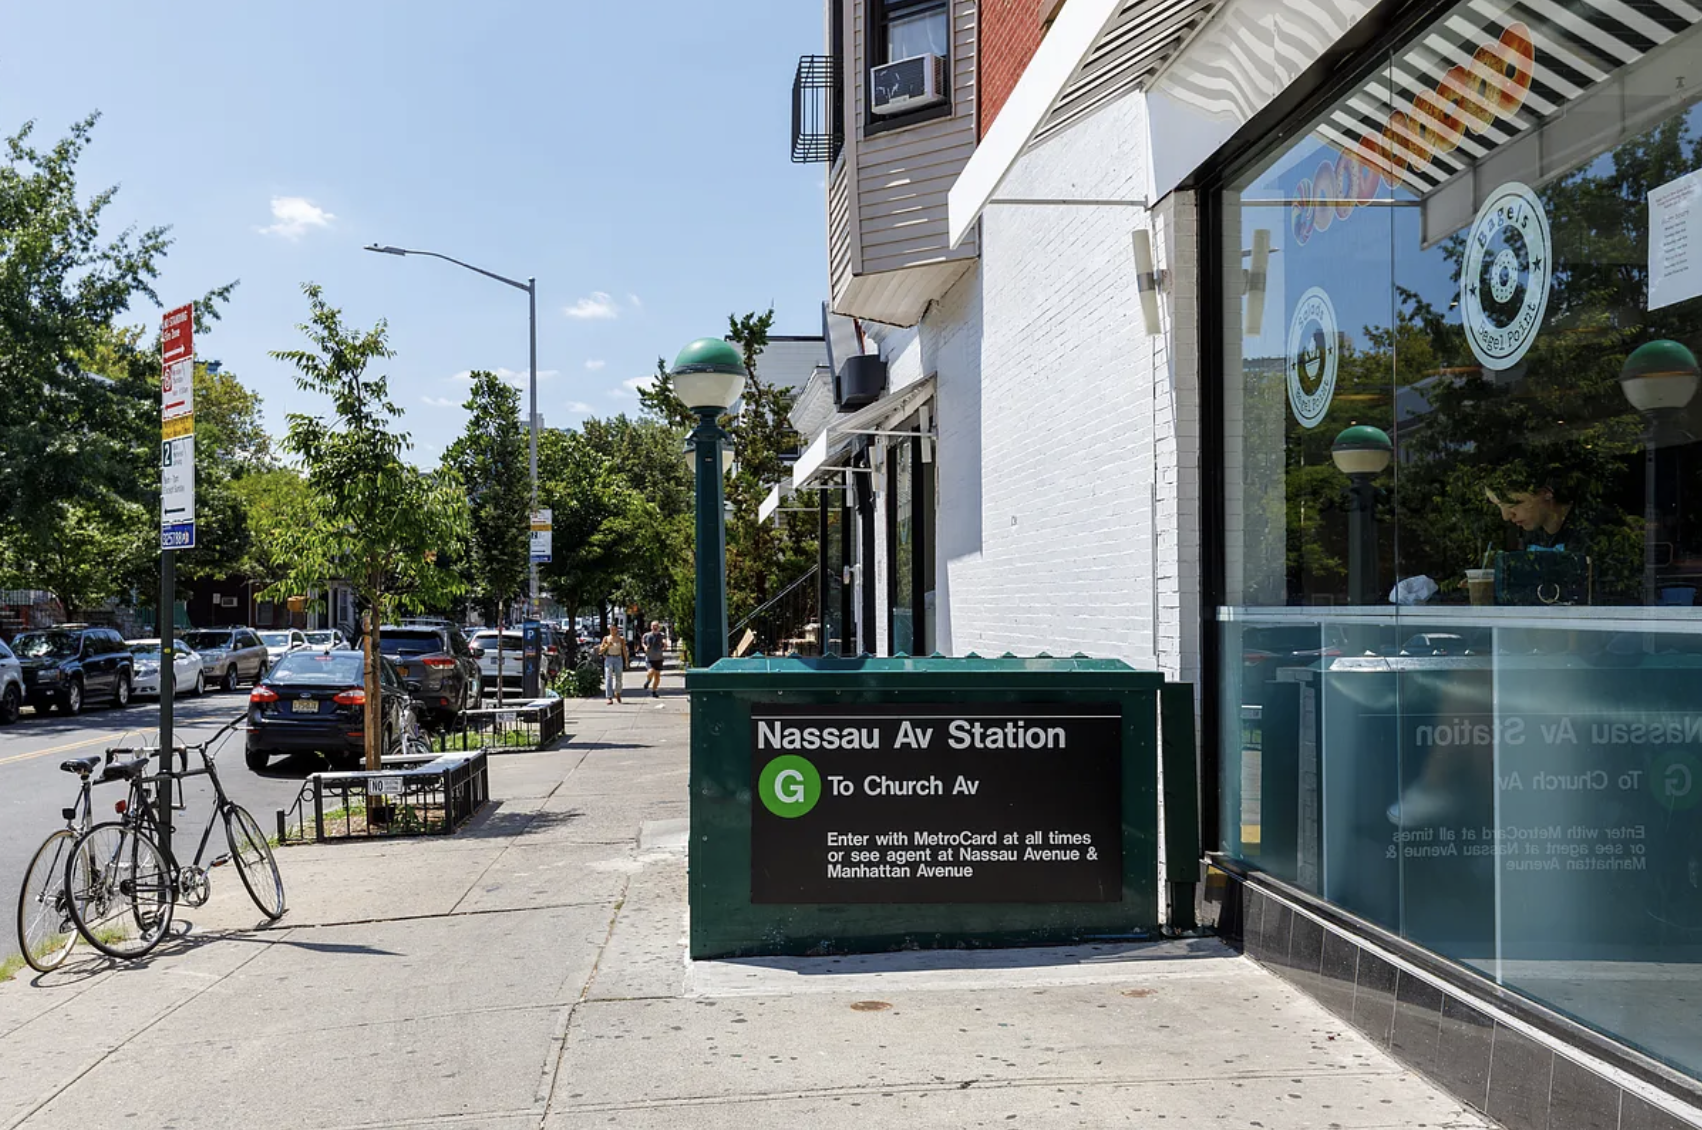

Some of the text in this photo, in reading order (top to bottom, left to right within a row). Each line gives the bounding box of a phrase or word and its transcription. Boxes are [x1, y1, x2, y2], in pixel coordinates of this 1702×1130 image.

[1477, 203, 1529, 250] Bagels
[1477, 302, 1536, 351] Bagel Point
[164, 443, 170, 465] 2
[757, 719, 1066, 750] Nassau Av Station
[372, 780, 383, 792] NO
[773, 768, 805, 804] G
[827, 775, 980, 796] To Church Av
[827, 831, 1092, 846] Enter with MetroCard at all times
[827, 846, 1099, 865] or see agent at Nassau Avenue &
[827, 862, 974, 879] Manhattan Avenue
